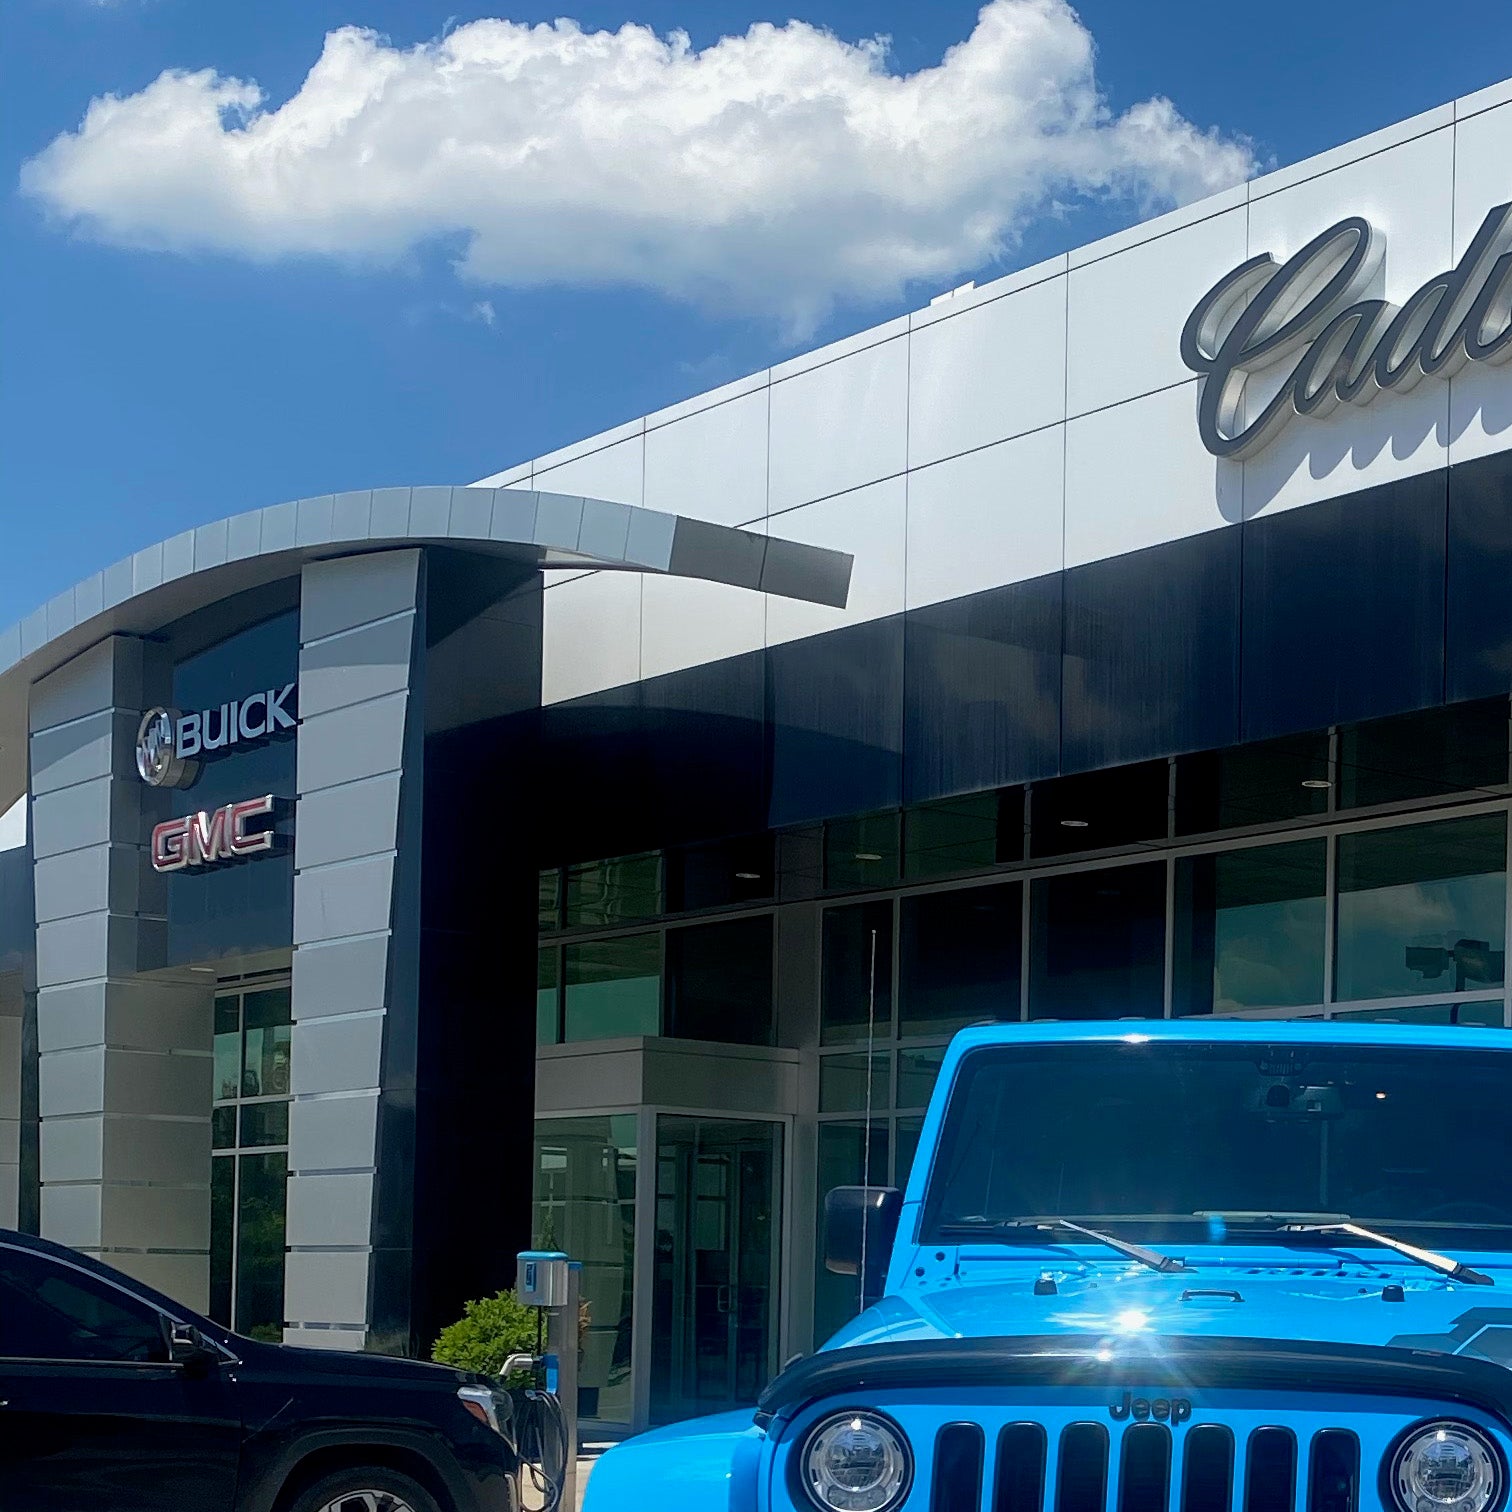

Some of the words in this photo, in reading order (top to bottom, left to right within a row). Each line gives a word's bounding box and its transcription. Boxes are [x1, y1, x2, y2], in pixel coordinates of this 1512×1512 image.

[176, 683, 296, 759] BUICK
[152, 794, 274, 873] GMC
[1109, 1391, 1192, 1427] Jeep
